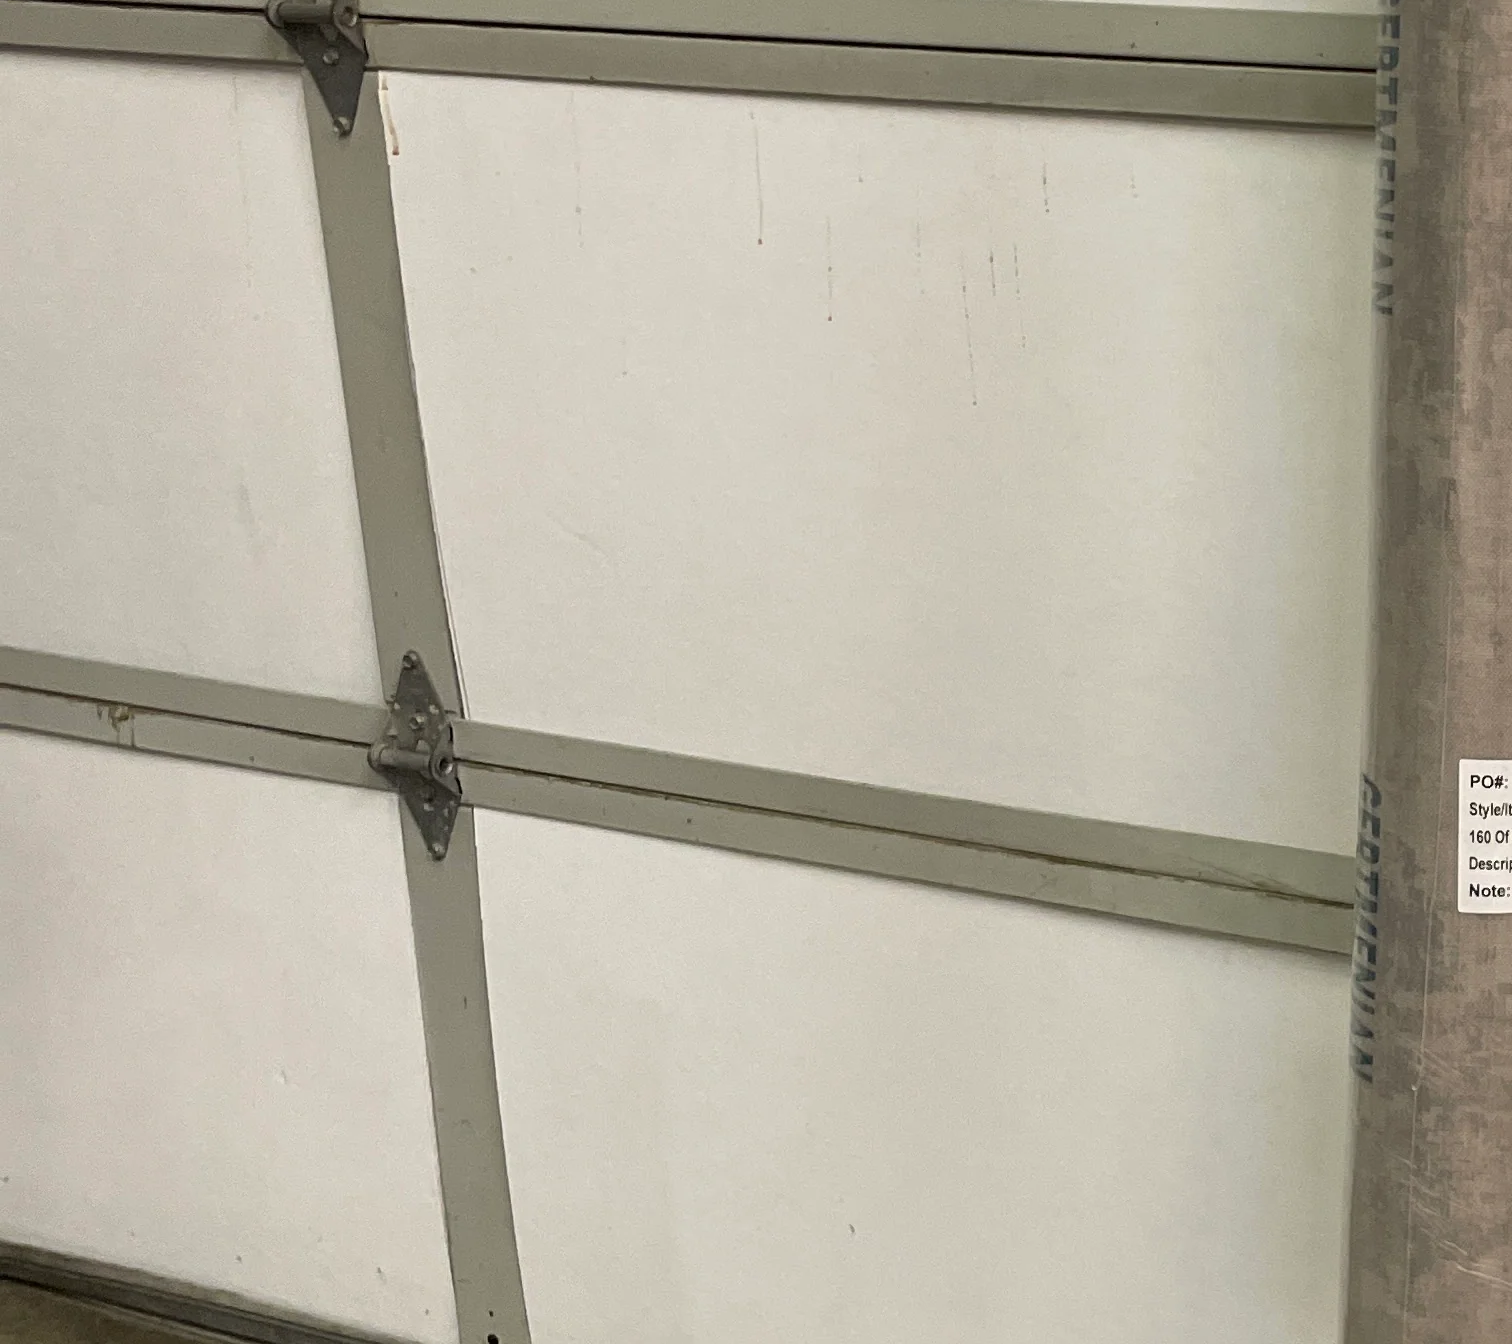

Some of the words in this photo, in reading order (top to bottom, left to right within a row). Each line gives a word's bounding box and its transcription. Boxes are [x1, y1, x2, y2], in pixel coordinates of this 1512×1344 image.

[1470, 775, 1508, 789] PO#:
[1469, 830, 1491, 844] 160
[1495, 829, 1511, 844] Of
[1469, 883, 1511, 898] Note:
